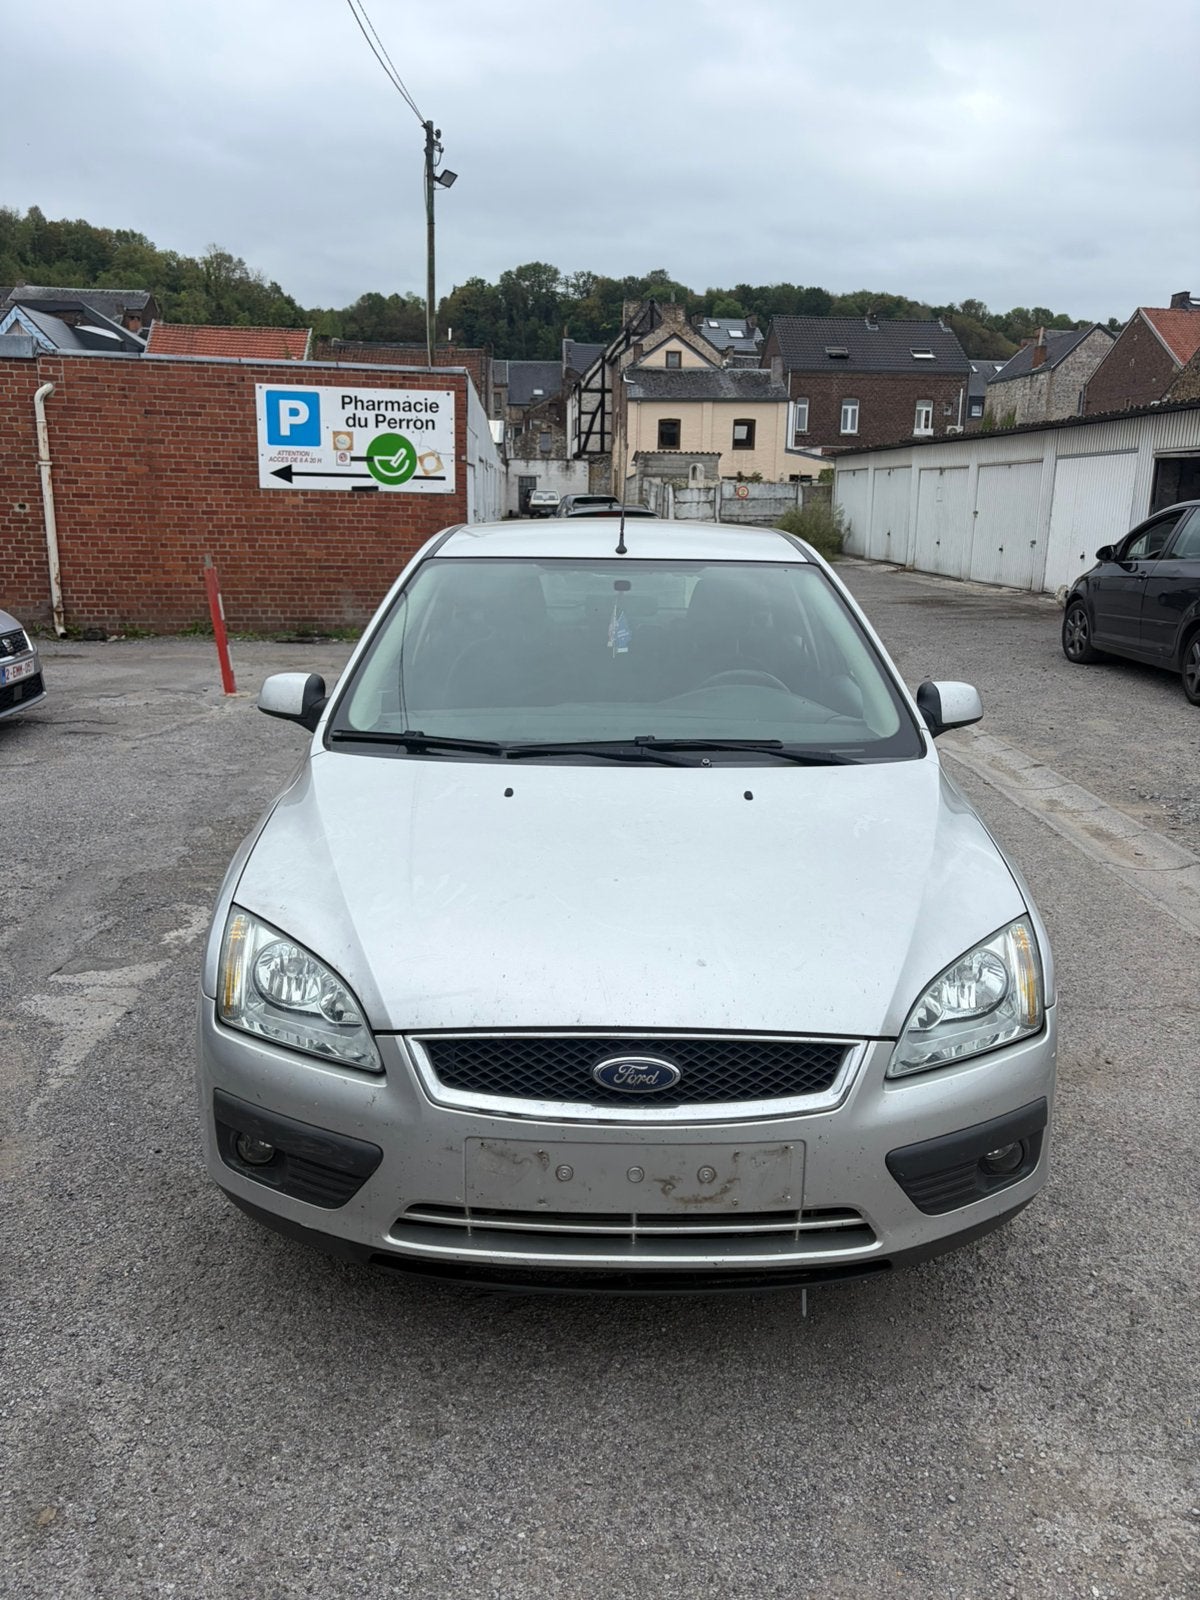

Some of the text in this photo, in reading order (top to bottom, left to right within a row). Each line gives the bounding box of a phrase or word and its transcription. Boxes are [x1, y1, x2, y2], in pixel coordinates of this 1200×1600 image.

[341, 394, 440, 414] Pharmacie
[278, 399, 310, 437] P
[345, 413, 436, 431] du Perron
[613, 1064, 660, 1085] Ford
